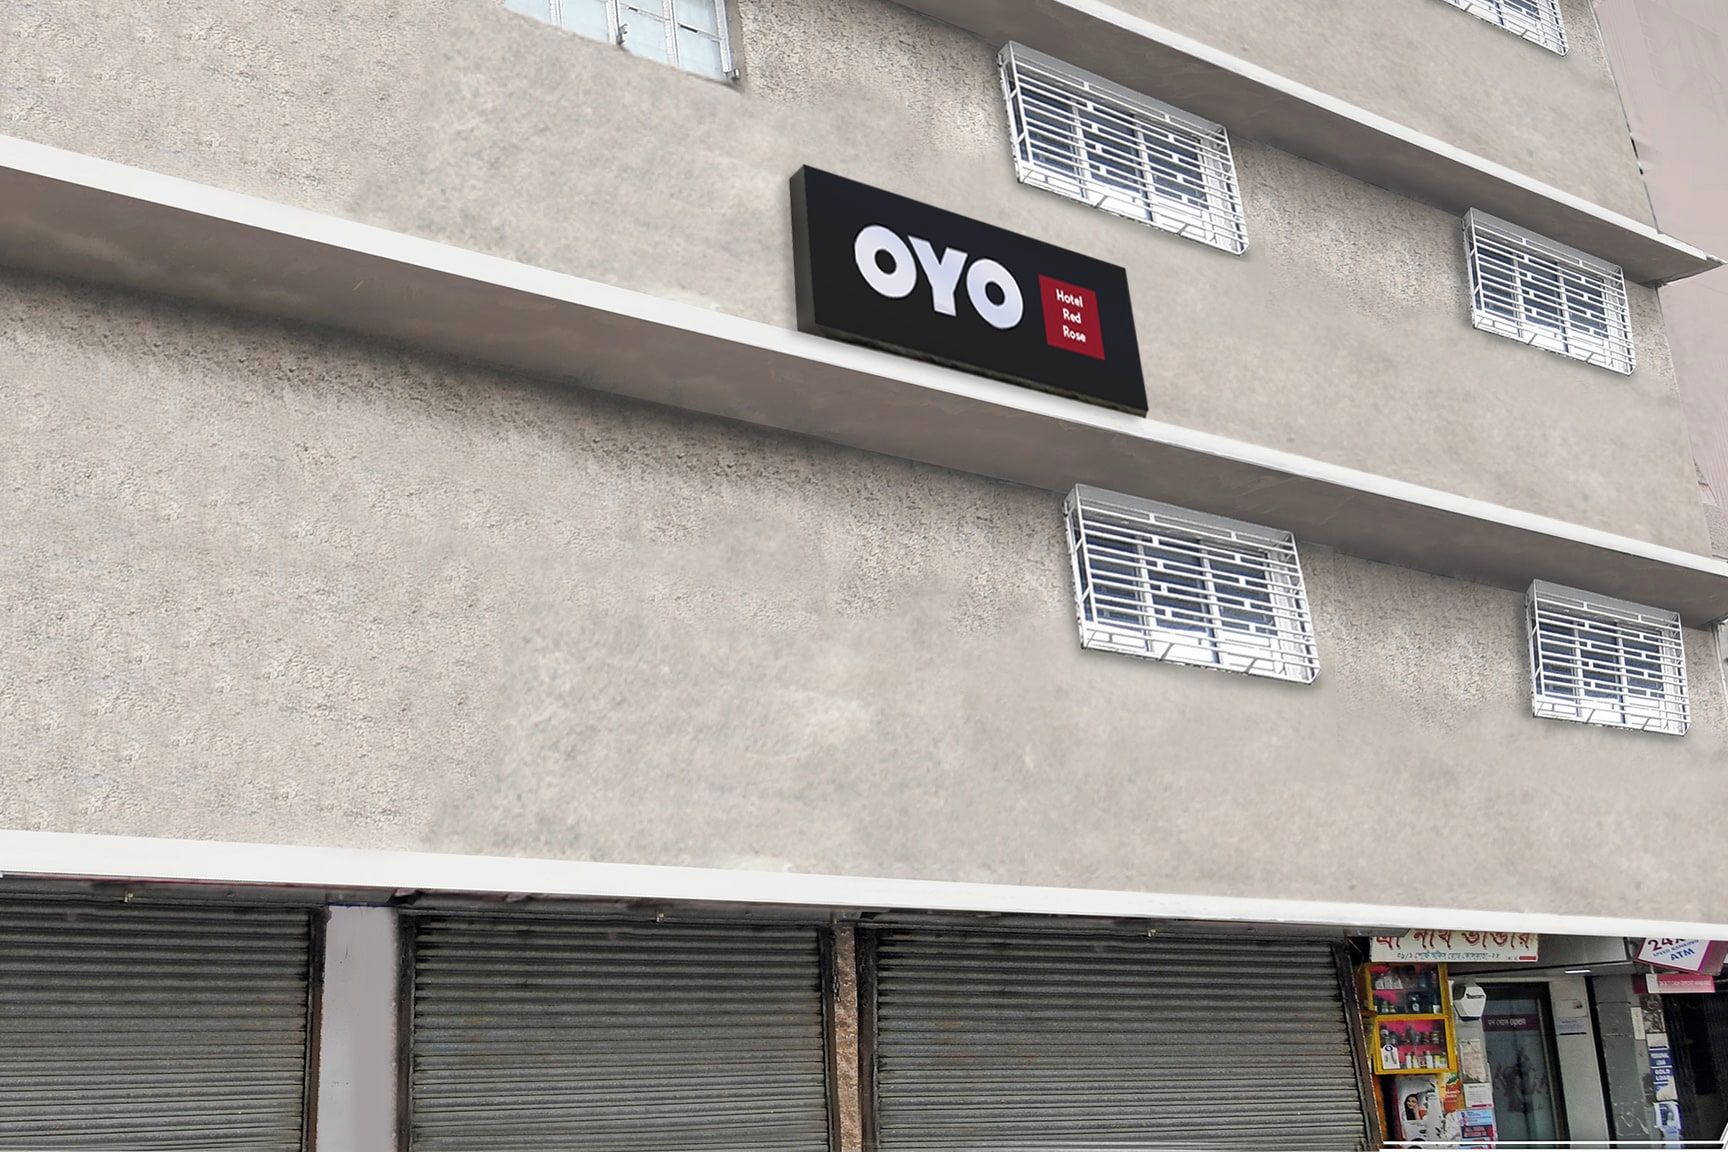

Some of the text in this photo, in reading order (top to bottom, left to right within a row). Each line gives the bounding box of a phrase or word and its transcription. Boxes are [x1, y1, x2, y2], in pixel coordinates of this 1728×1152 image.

[854, 225, 1023, 329] OYO
[1056, 288, 1083, 308] Hotel
[1063, 308, 1082, 324] Red
[1063, 325, 1086, 343] Rose
[1671, 948, 1695, 960] ATM
